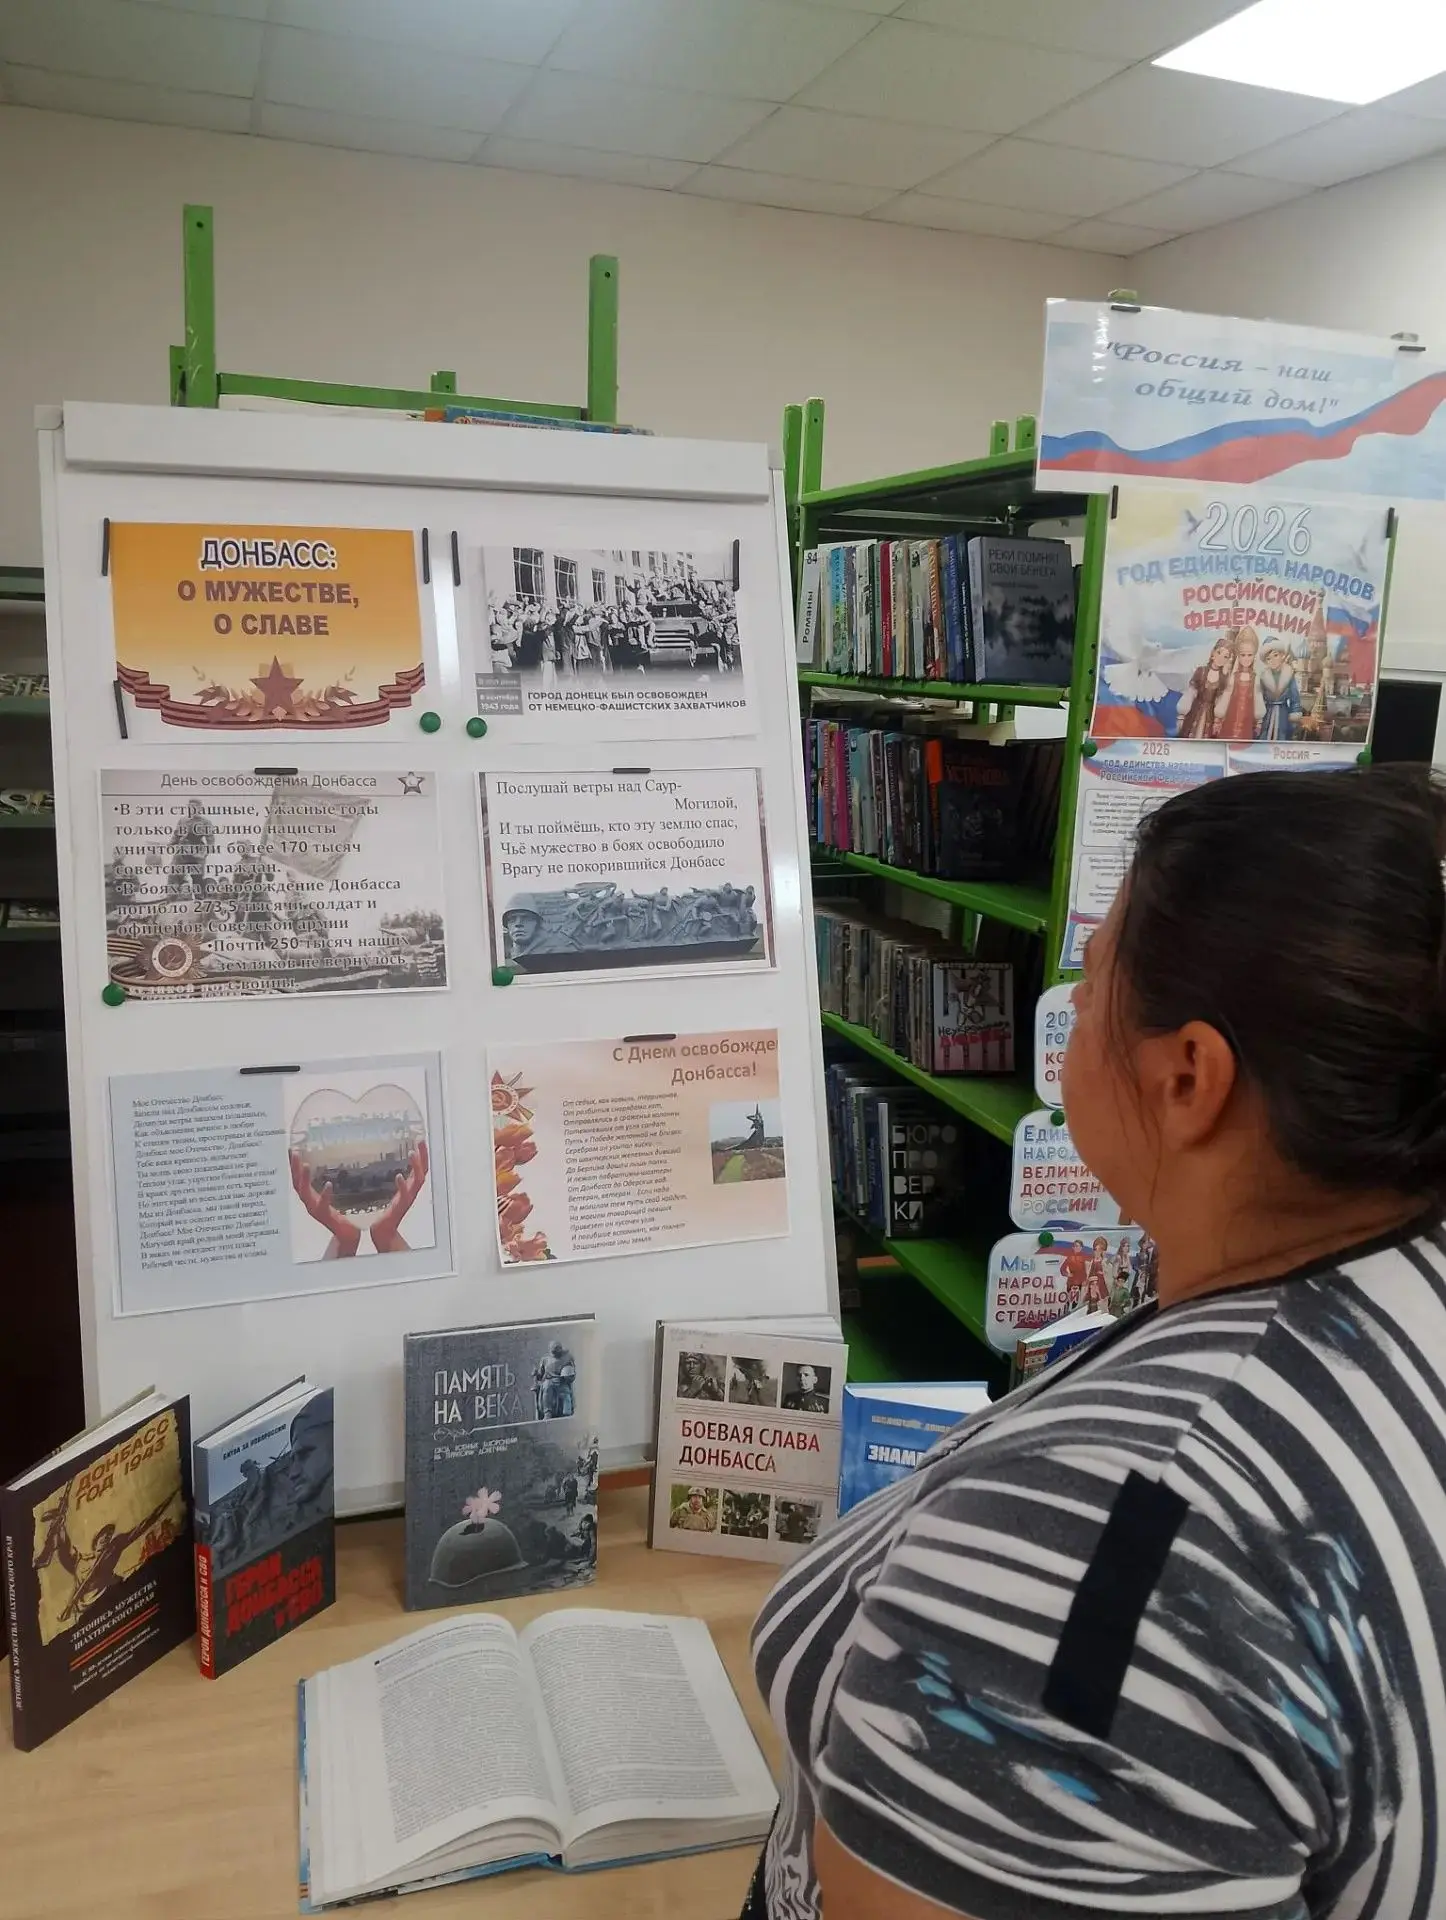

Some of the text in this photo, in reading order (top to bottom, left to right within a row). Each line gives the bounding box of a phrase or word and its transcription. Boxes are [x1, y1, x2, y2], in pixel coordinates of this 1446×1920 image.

[1106, 341, 1243, 372] "Россия
[1278, 363, 1333, 382] наш
[1135, 379, 1339, 415] общий дом!"
[1199, 501, 1314, 556] 2026
[200, 539, 337, 570] ДОНБАСС:
[1117, 554, 1375, 600] ГОД ЕДИНСТВА НАРОДОВ
[177, 580, 359, 609] О МУЖЕСТВЕ,
[1183, 577, 1318, 614] РОССИЙСКОЙ
[214, 614, 330, 636] О СЛАВЕ
[802, 591, 813, 643] Романы
[1183, 608, 1312, 635] ФЕДЕРАЦИИ
[528, 690, 708, 701] ГОРОД ДОНЕЦК БЫЛ ОСВОБОЖДЕН
[528, 699, 747, 713] ОТ НЕМЕЦКО-ФАШИСТСКИХ ЗАХВАТЧИКОВ
[500, 703, 520, 711] года
[1143, 742, 1170, 755] 2026
[161, 773, 377, 789] День освобождения Донбасса
[496, 779, 682, 797] Послушай ветры над Саур-
[136, 804, 164, 815] эти
[170, 804, 259, 818] страшные,
[264, 805, 336, 817] ужасные
[341, 804, 379, 816] годы
[675, 797, 738, 811] Могилой,
[115, 823, 337, 836] только в Сталино нацисты
[499, 817, 738, 836] И ты поймёшь, кто эту землю спас,
[115, 841, 361, 856] уничтожили более 170 тысяч
[501, 837, 725, 857] Чьё мужество в боях освободило
[115, 863, 281, 877] советских граждан.
[502, 856, 726, 878] Врагу не покорившийся Донбасс
[140, 882, 178, 895] боях
[183, 884, 200, 894] за
[206, 881, 324, 894] освобождение
[329, 879, 401, 892] Донбасса
[118, 902, 188, 915] погибло
[194, 900, 237, 914] 273,5
[309, 900, 362, 912] солдат
[368, 900, 377, 909] и
[118, 919, 350, 937] офицеров Советской армии
[271, 937, 299, 950] 250
[306, 937, 352, 949] тысяч
[358, 935, 410, 947] наших
[302, 958, 320, 968] не
[1045, 1032, 1066, 1046] ГО
[613, 1039, 777, 1064] С Днем освобожде
[671, 1061, 757, 1086] Донбасса!
[892, 1124, 957, 1145] БЮРО
[892, 1150, 938, 1169] ПРО
[1023, 1146, 1079, 1162] НАРОД
[1022, 1165, 1091, 1180] ВЕЛИЧИ
[894, 1175, 936, 1195] ВЕР
[1020, 1182, 1106, 1198] ДОСТОЯН
[1020, 1198, 1098, 1215] РОССИИ!
[998, 1275, 1054, 1290] НАРОД
[996, 1285, 1080, 1306] БОЛЬШОЙ
[434, 1363, 516, 1396] ПАМЯТЬ
[434, 1391, 524, 1425] НА ВЕКА
[681, 1419, 821, 1453] БОЕВАЯ СЛАВА
[75, 1416, 170, 1493] ДОНБАСС
[679, 1445, 776, 1474] ДОНБАССА
[868, 1444, 926, 1470] ЗНАМ
[76, 1437, 167, 1513] ГОД 1943
[6, 1535, 14, 1559] КРАЯ
[8, 1560, 18, 1621] ШАХТЕРСКОГО
[70, 1579, 158, 1643] ЛЕТОПИСЬ МУЖЕСТВА
[74, 1590, 155, 1651] ШАХТЕРСКОГО КРАЯ
[198, 1554, 211, 1667] ГЕРОИ ДОНБАССА СВО
[11, 1622, 20, 1668] МУЖЕСТВА
